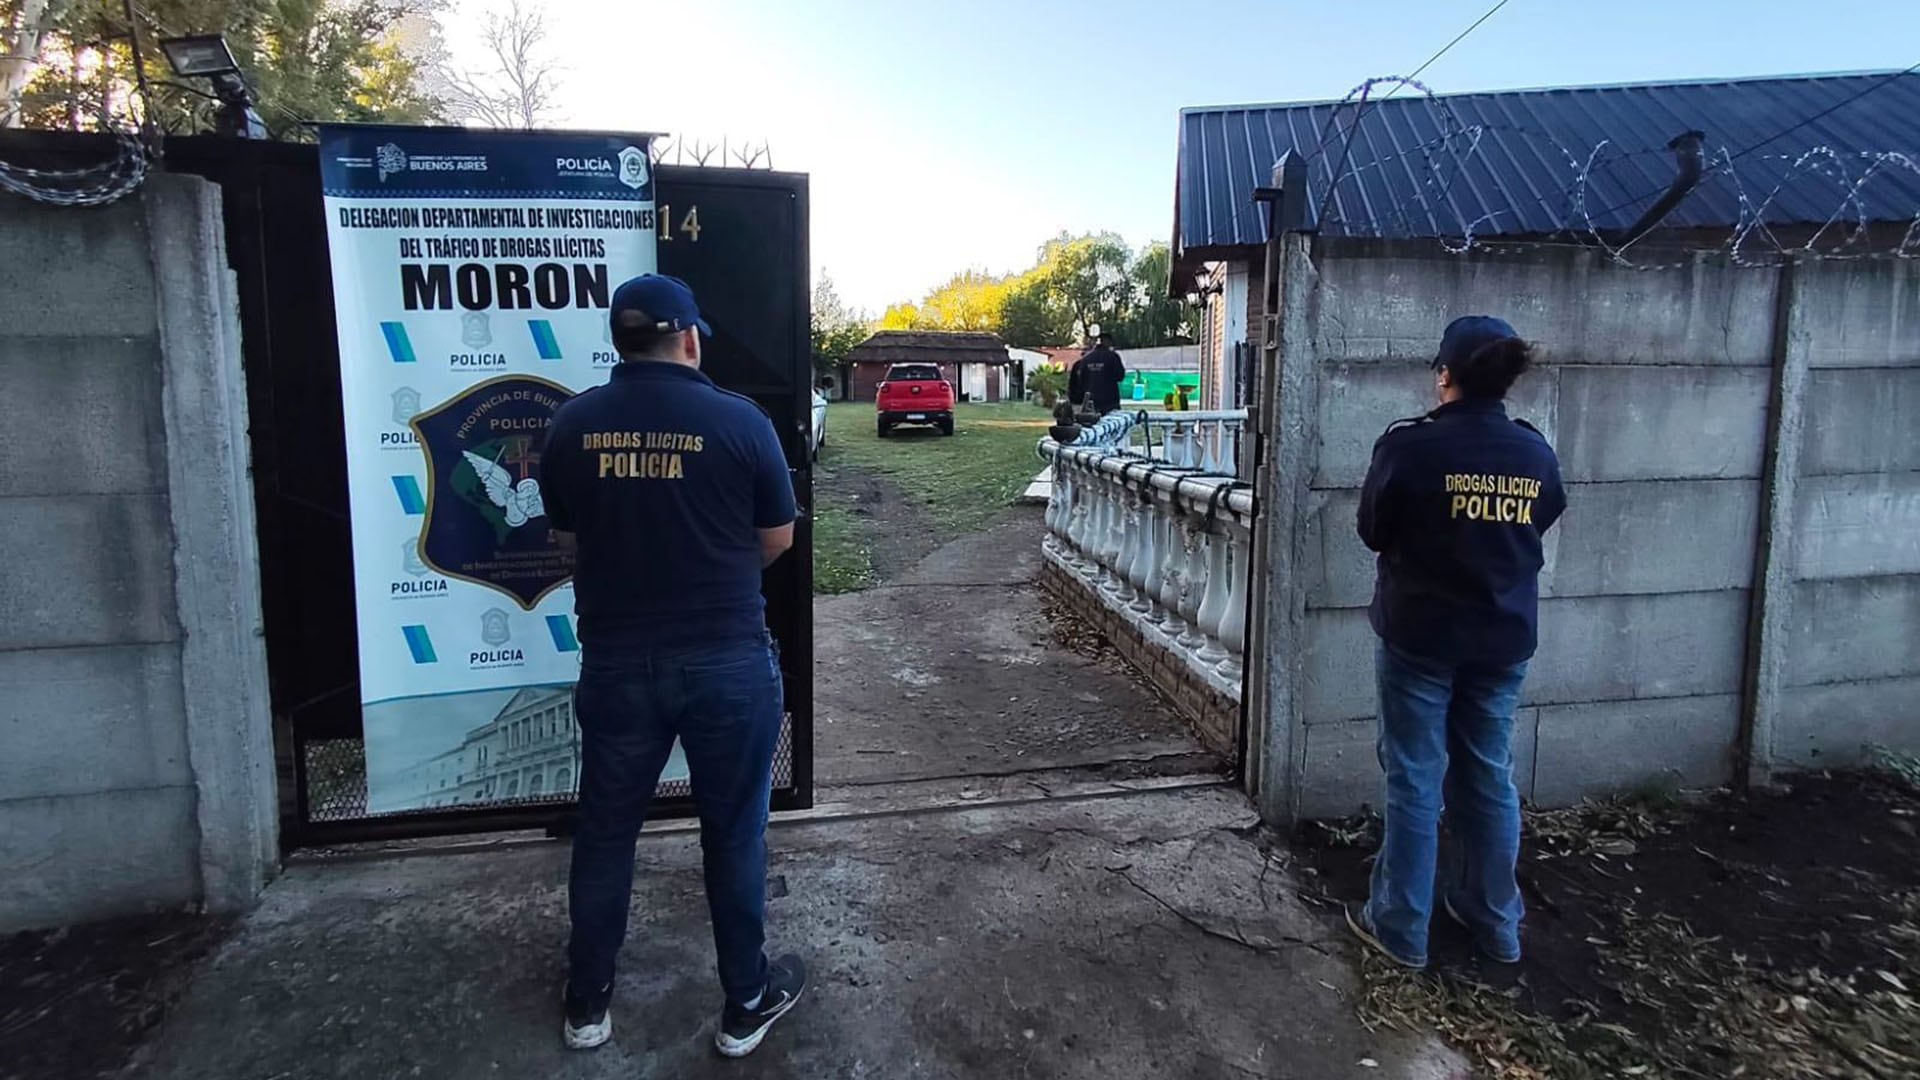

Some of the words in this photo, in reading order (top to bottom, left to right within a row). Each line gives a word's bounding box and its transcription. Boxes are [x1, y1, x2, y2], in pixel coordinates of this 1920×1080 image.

[409, 161, 455, 171] BUENOS
[456, 161, 488, 171] AIRES
[339, 207, 419, 228] DELEGACION
[422, 207, 526, 229] DEPARTAMENTAL
[528, 208, 544, 228] DE
[546, 208, 654, 230] INVESTIGACIONES
[400, 238, 423, 259] DEL
[425, 234, 479, 259] TRÁFICO
[482, 238, 498, 258] DE
[500, 238, 551, 258] DROGAS
[553, 234, 606, 259] ILÍCITAS
[400, 262, 610, 312] MORON
[450, 353, 507, 366] POLICIA
[456, 391, 511, 440] PROVINCIA
[514, 391, 531, 401] DE
[534, 392, 559, 411] BUE
[490, 416, 553, 431] POLICIA
[381, 432, 421, 445] POLIC
[583, 432, 641, 450] DROGAS
[646, 432, 704, 452] ILICITAS
[598, 452, 684, 478] POLICIA
[1445, 474, 1496, 493] DROGAS
[1497, 475, 1542, 499] ILICITAS
[1451, 495, 1532, 525] POLICIA
[391, 579, 448, 594] POLICIA
[470, 649, 524, 664] POLICIA
